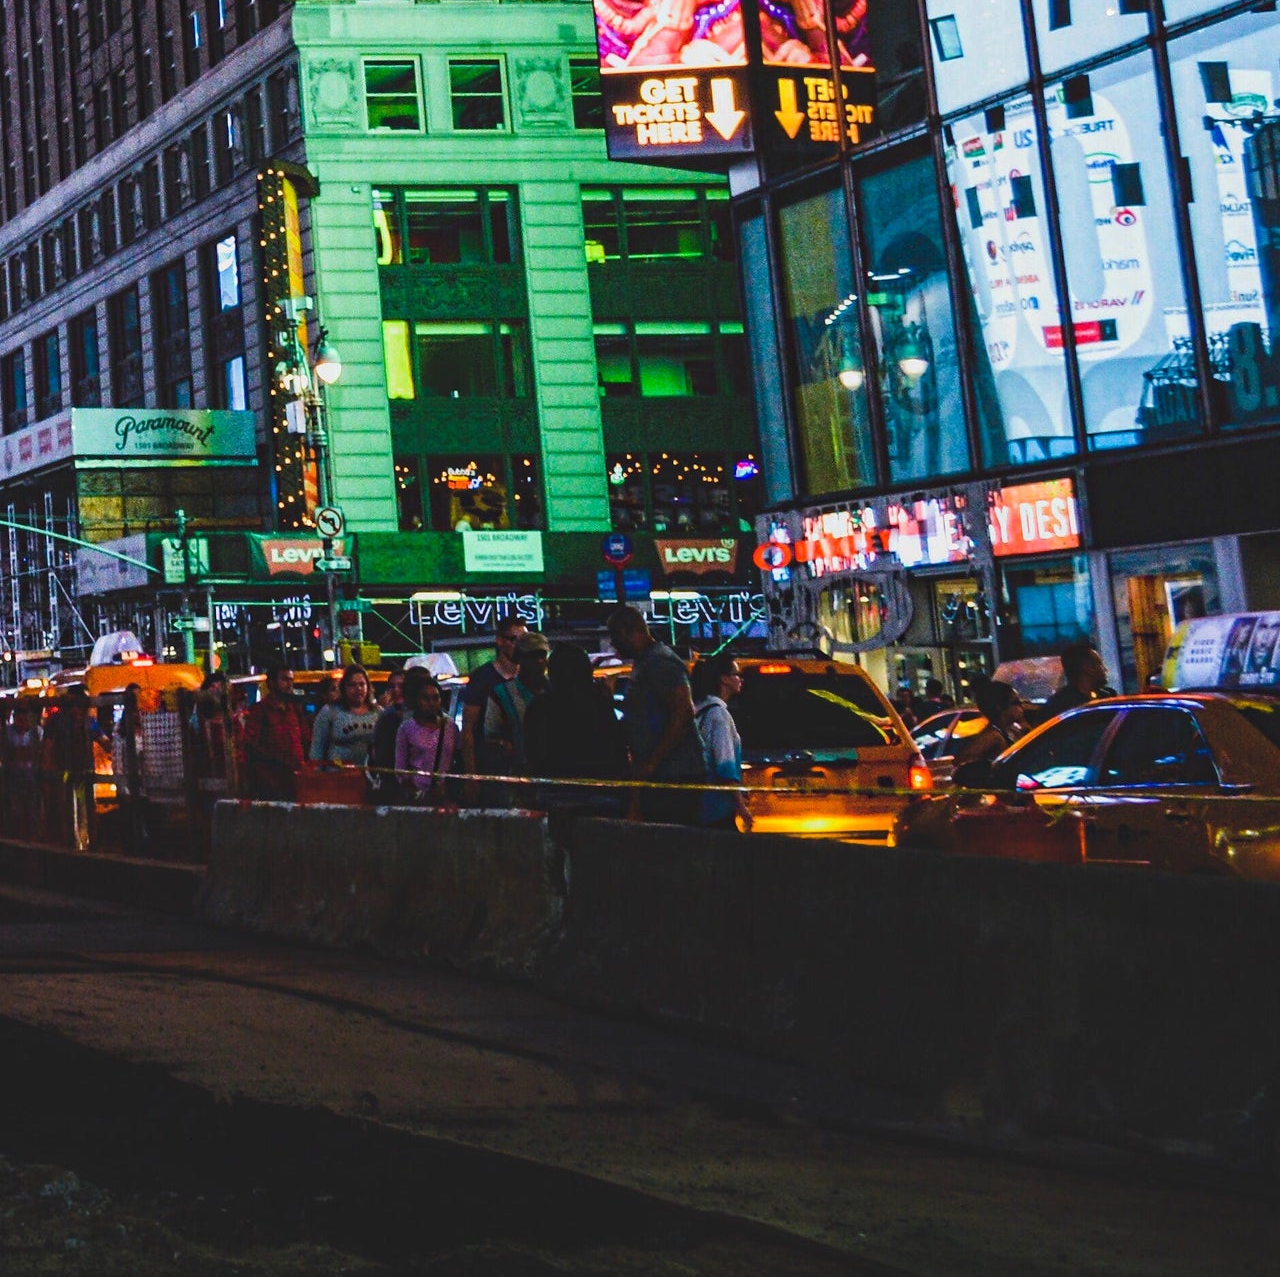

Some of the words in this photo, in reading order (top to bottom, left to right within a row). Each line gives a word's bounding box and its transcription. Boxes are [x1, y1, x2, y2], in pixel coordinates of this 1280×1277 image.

[640, 78, 698, 103] GET
[612, 101, 702, 126] TICKETS
[637, 120, 703, 145] HERE
[115, 415, 216, 451] Paramount
[664, 546, 731, 564] Levi's
[409, 590, 544, 625] Levi's
